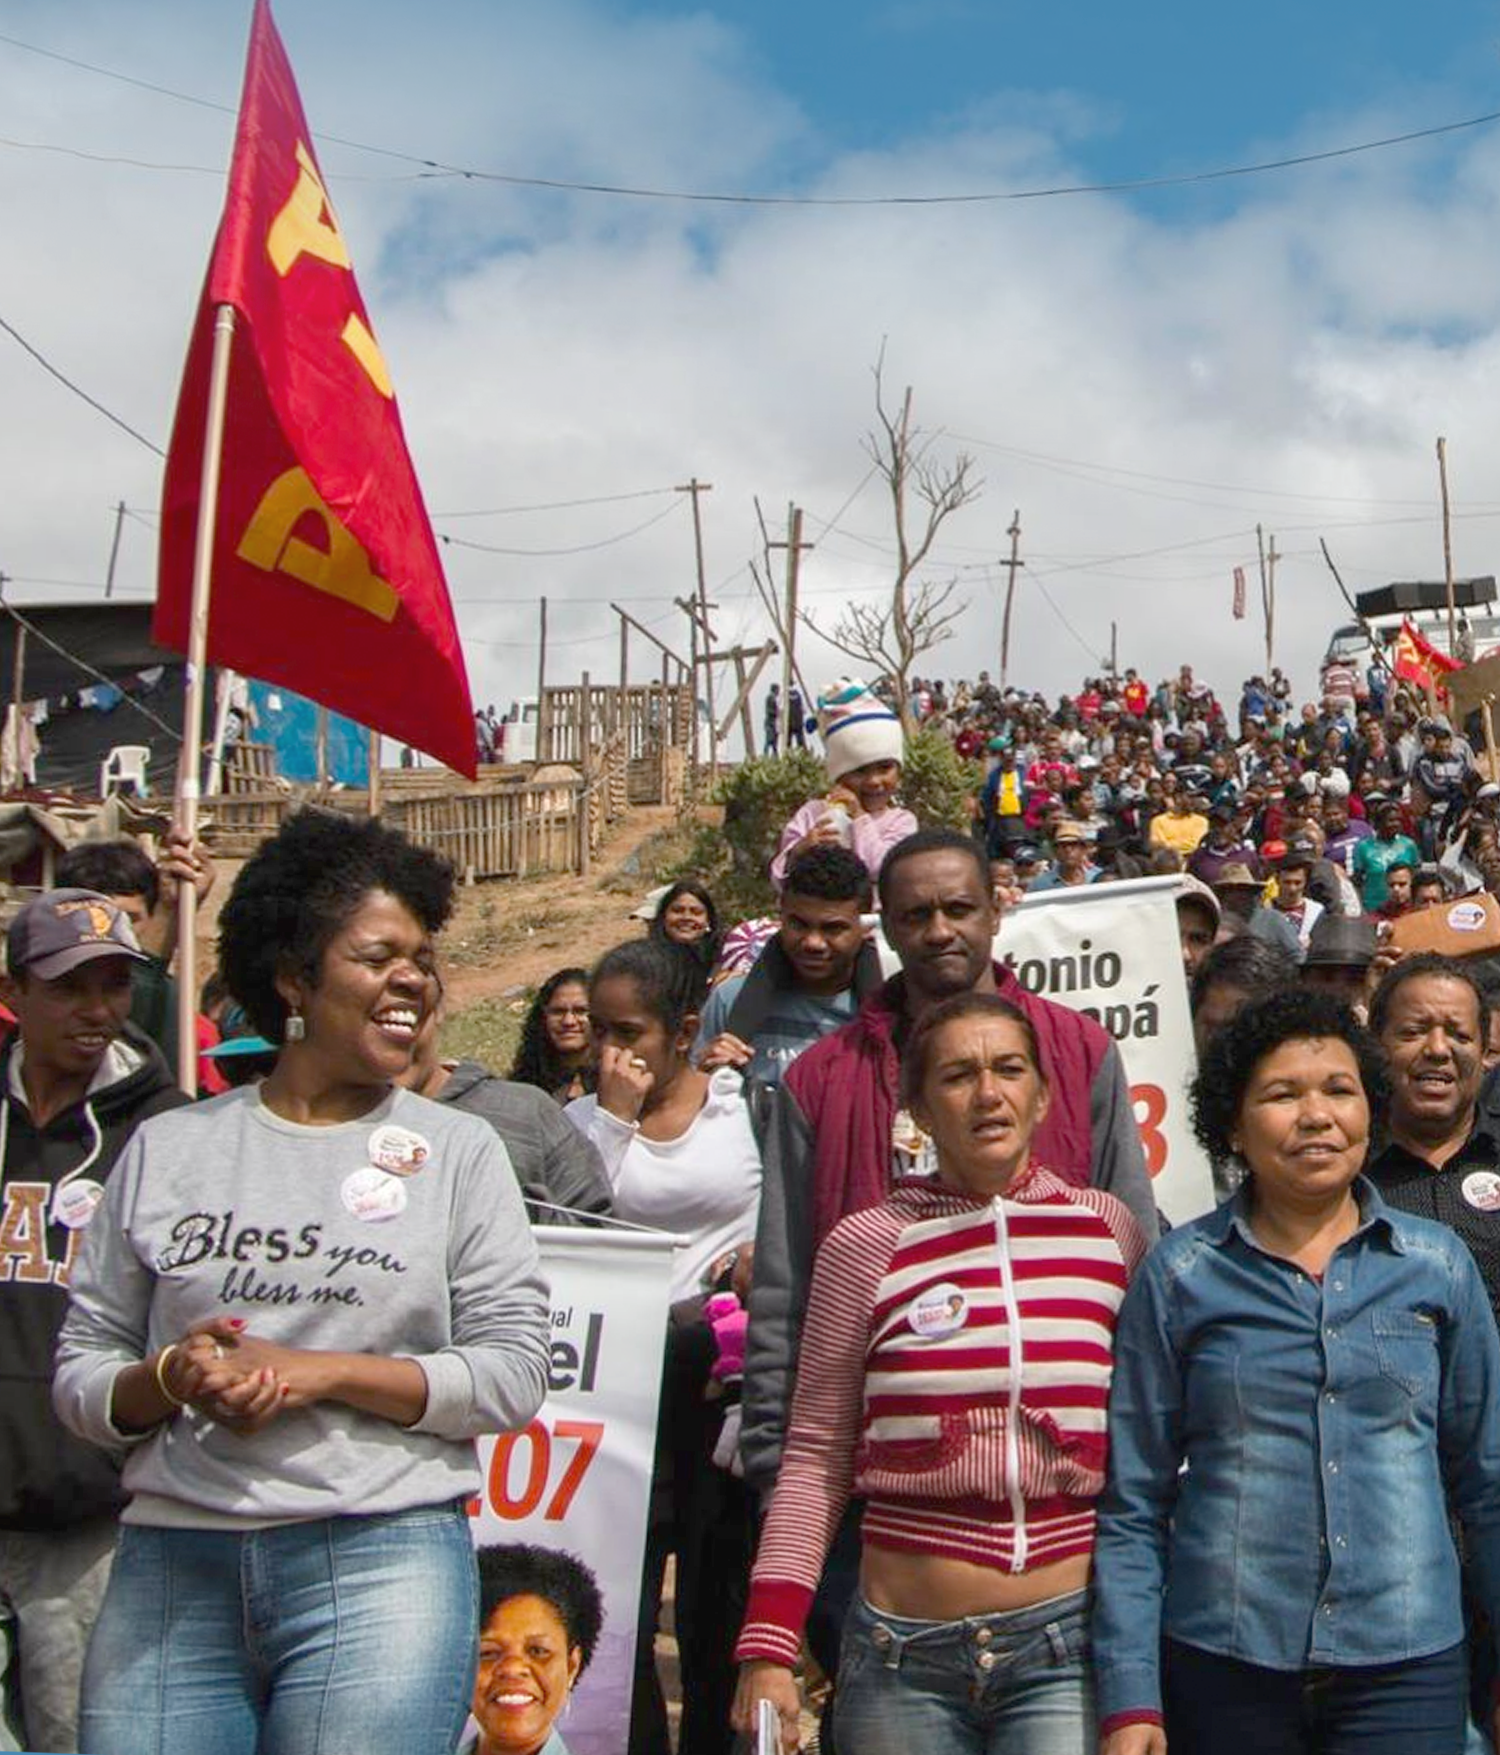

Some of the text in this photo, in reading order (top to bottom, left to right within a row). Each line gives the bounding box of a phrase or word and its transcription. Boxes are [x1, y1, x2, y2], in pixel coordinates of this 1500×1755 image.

[156, 1210, 408, 1278] Bless you
[217, 1266, 302, 1304] bless
[548, 1313, 604, 1390] el
[466, 1419, 605, 1522] 07
